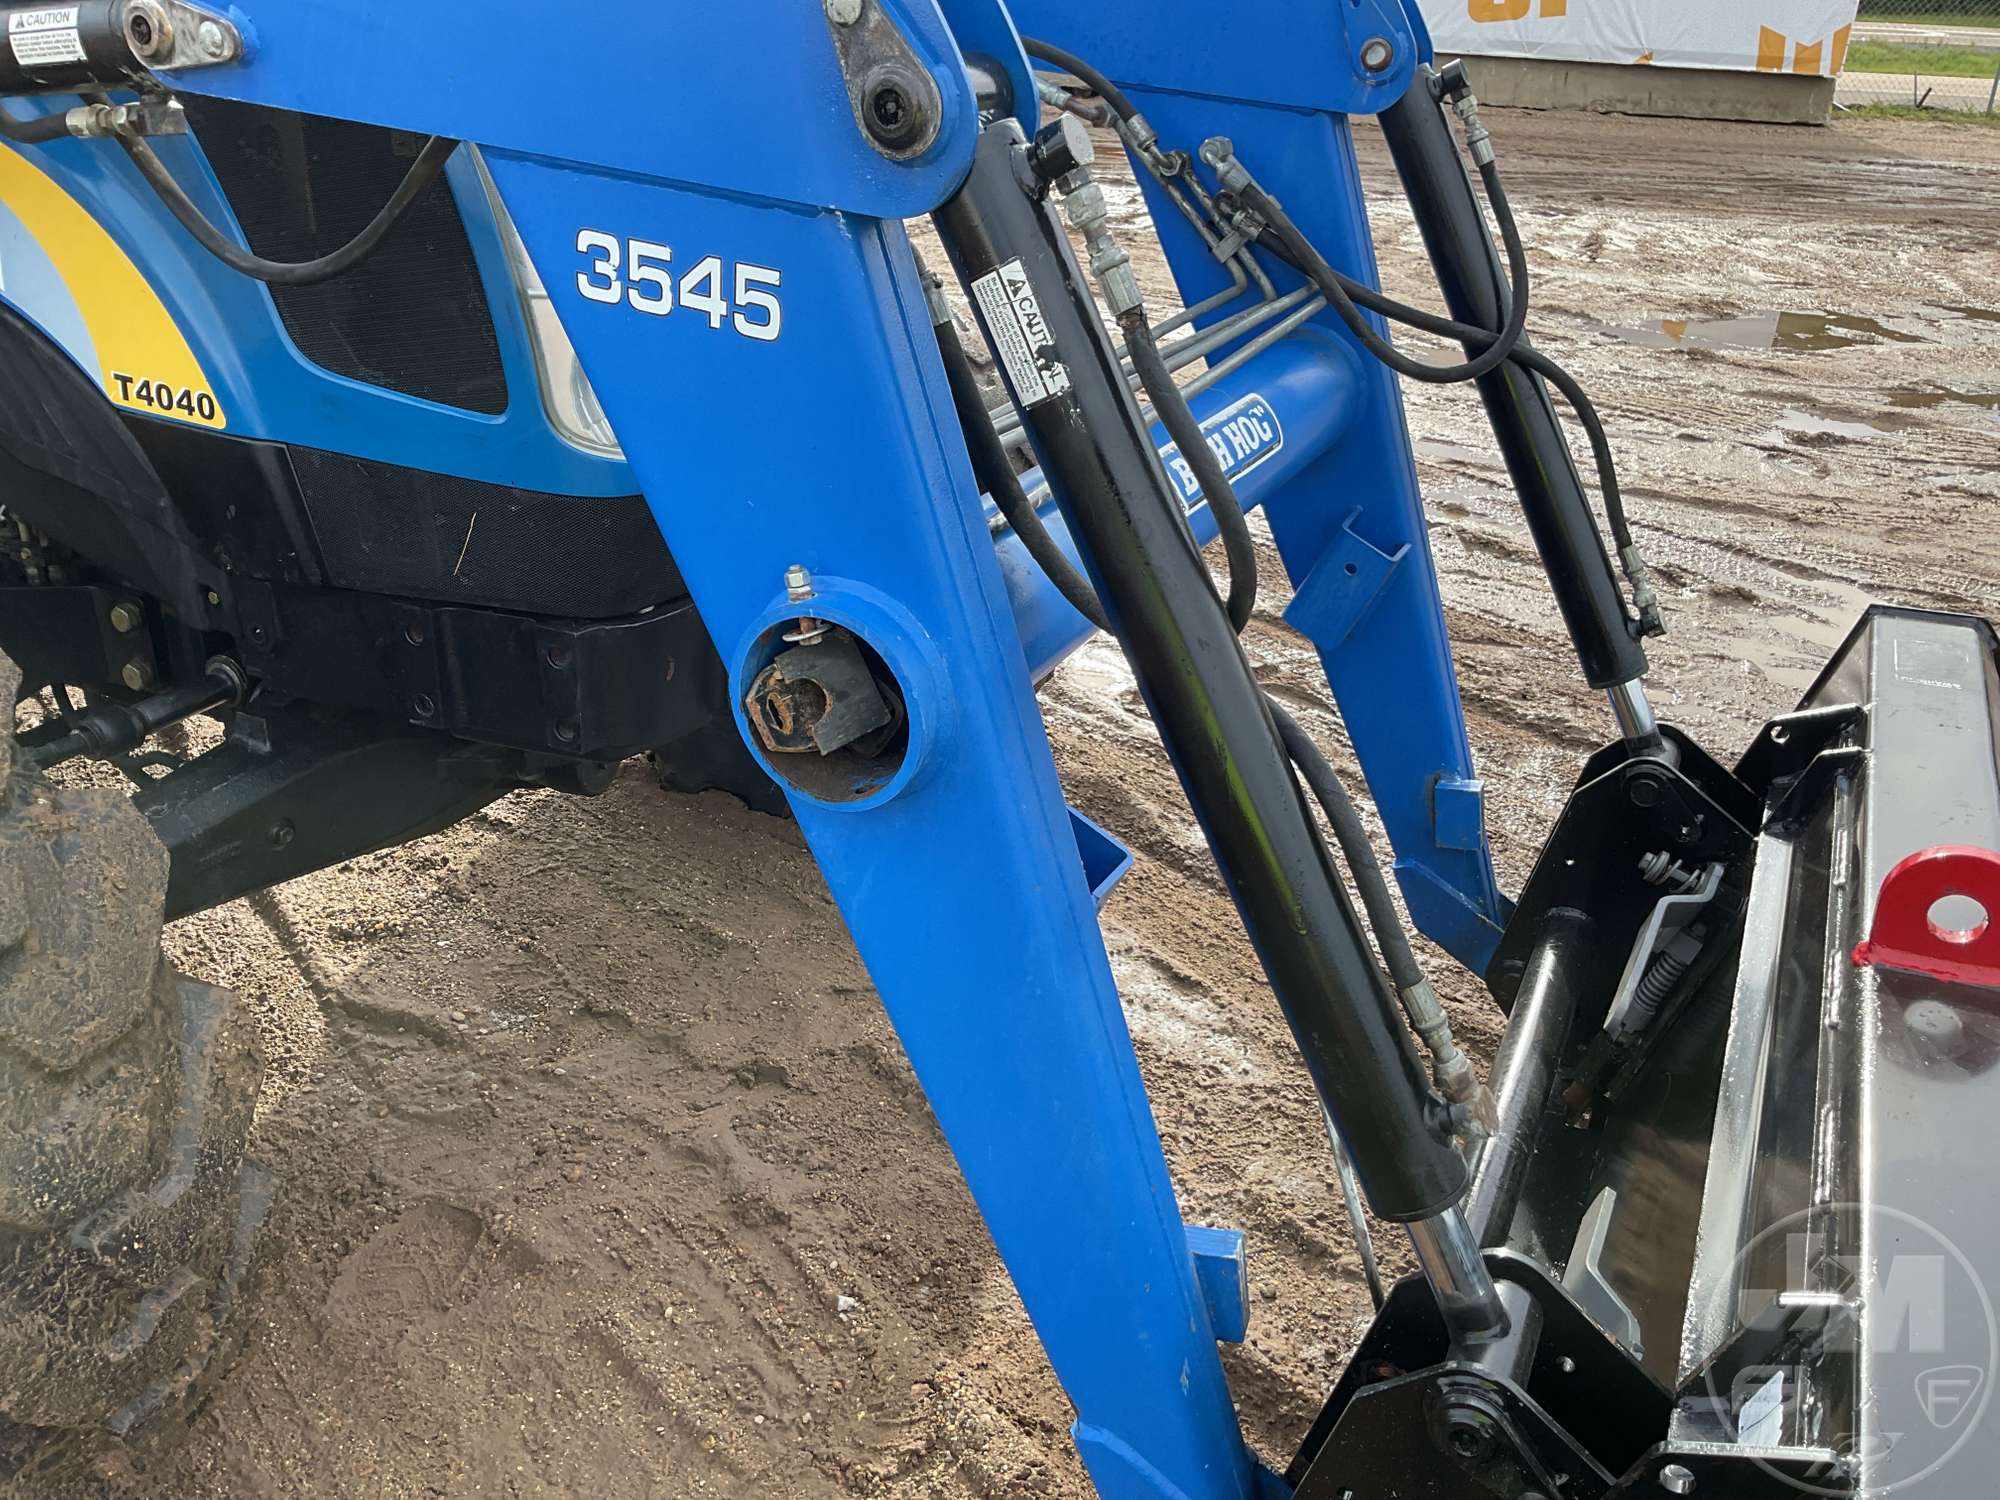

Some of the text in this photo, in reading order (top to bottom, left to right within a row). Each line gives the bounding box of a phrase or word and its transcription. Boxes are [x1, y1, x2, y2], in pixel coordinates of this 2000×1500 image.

[26, 10, 70, 26] CAUTION
[575, 227, 783, 343] 3545
[1018, 297, 1063, 386] CAUTN
[112, 372, 216, 421] T4040
[1168, 432, 1236, 497] BH
